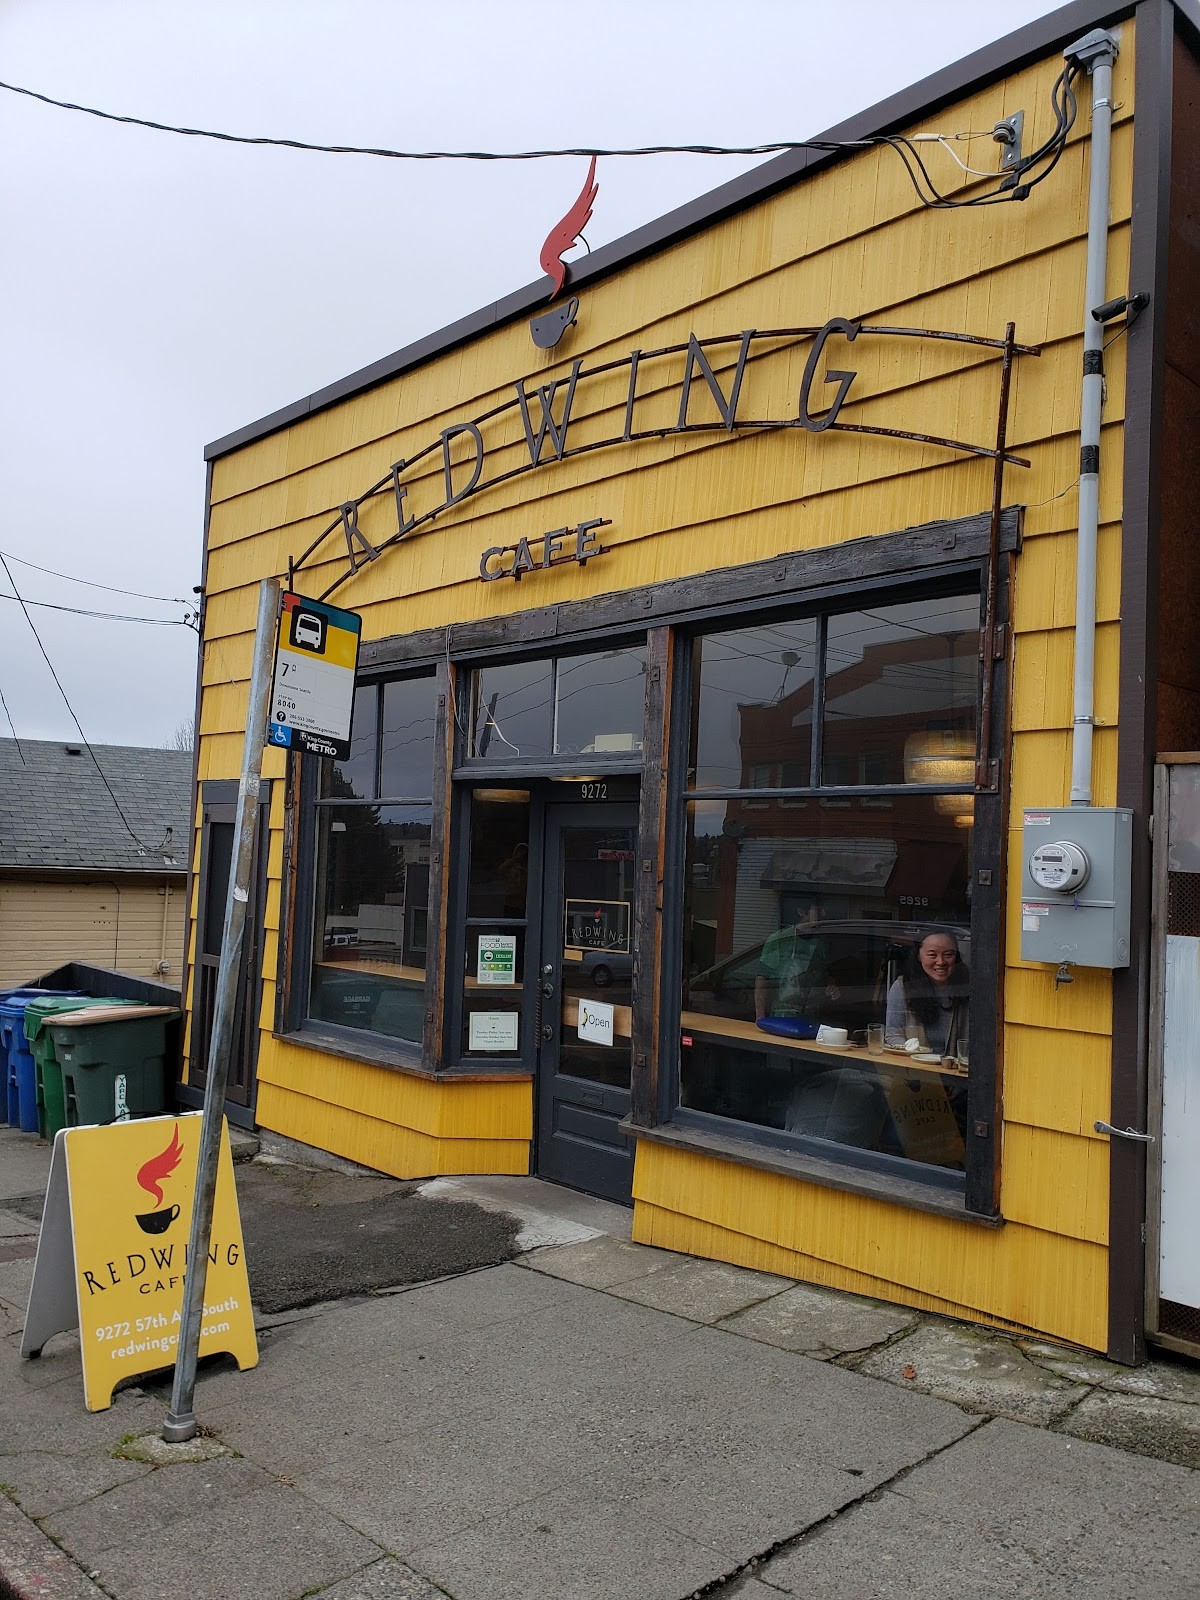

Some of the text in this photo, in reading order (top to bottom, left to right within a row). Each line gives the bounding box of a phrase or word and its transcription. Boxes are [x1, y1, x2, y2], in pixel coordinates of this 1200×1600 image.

[338, 316, 861, 575] REDWING
[480, 517, 602, 580] CAFE
[281, 662, 289, 677] 7
[277, 699, 296, 710] 8040
[306, 741, 338, 755] METRO
[308, 735, 332, 747] King County
[581, 783, 607, 799] 9272
[572, 925, 624, 945] REDWING
[589, 939, 605, 947] CAFE
[588, 1014, 610, 1029] Open
[96, 1322, 131, 1342] 9272
[135, 1312, 168, 1333] 57th
